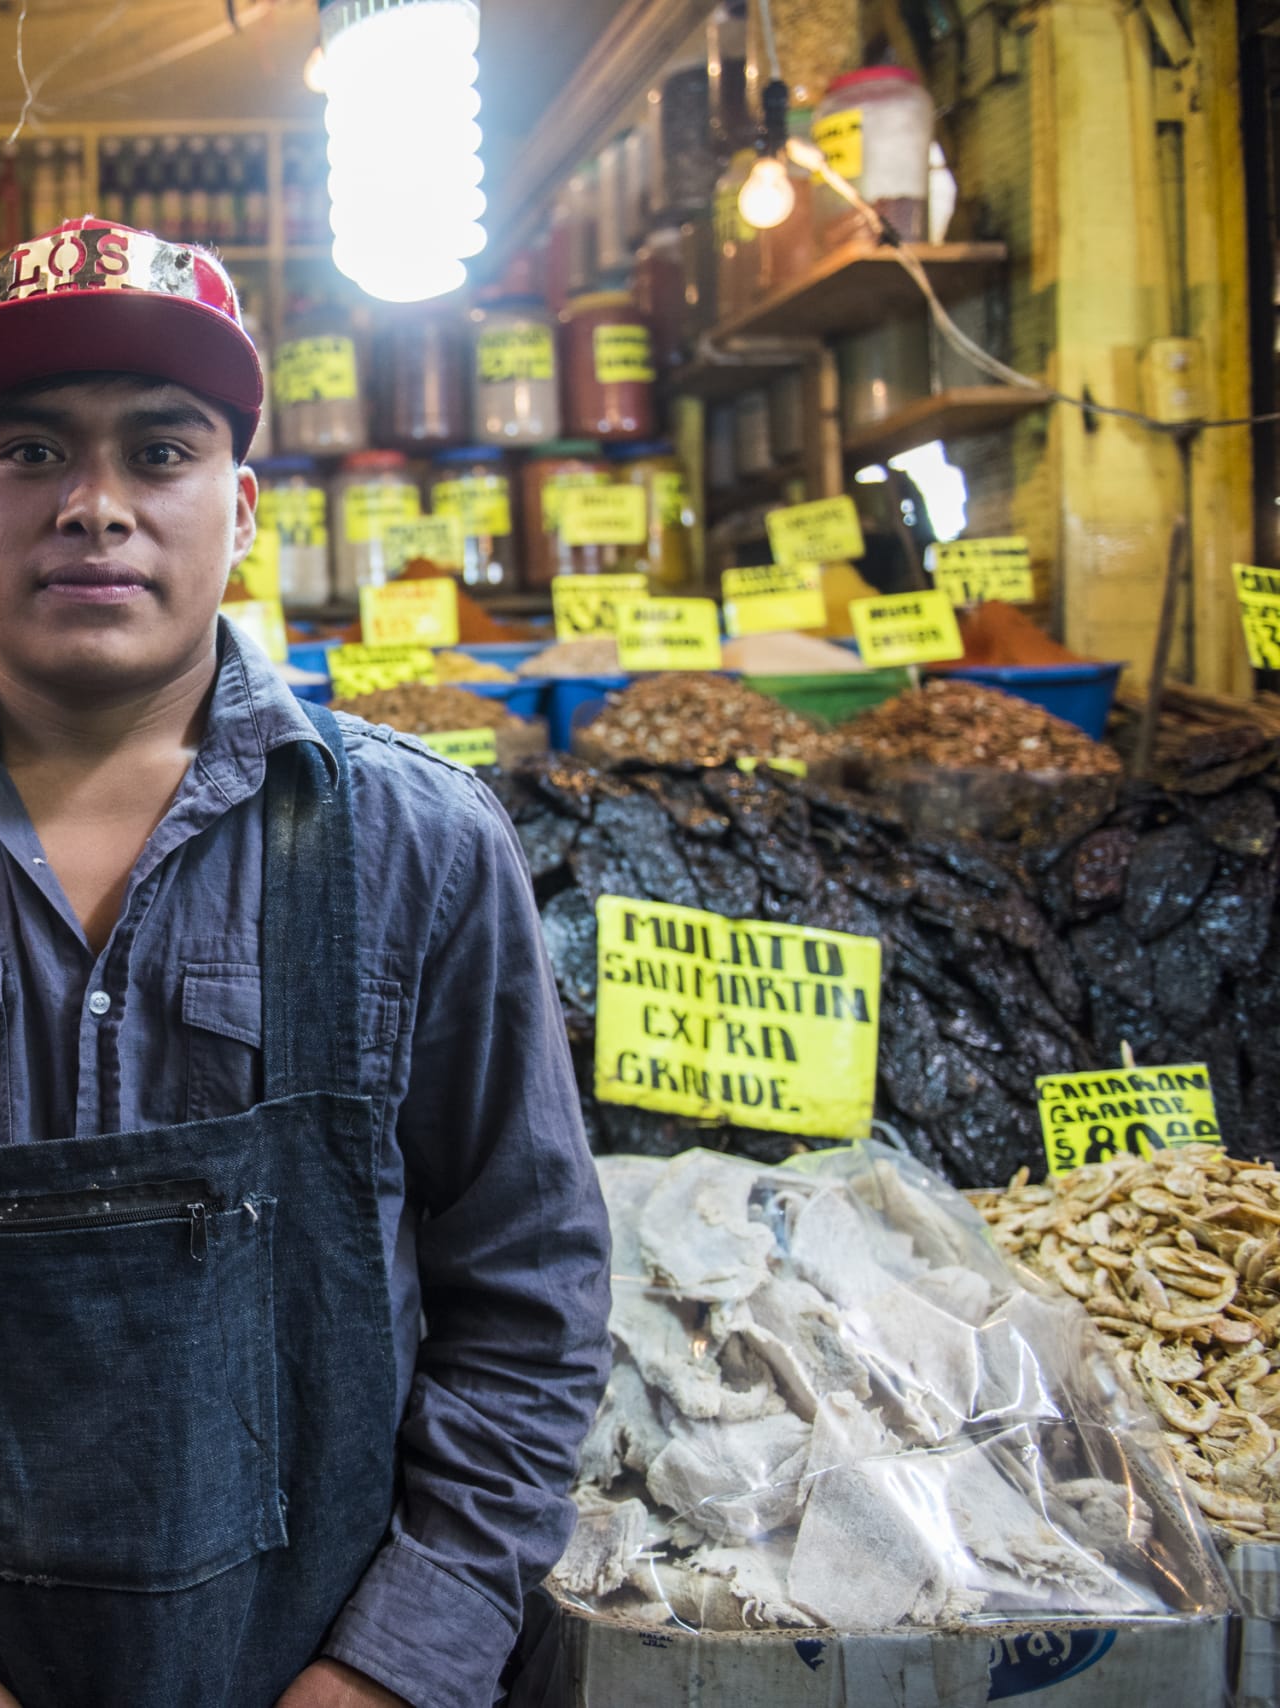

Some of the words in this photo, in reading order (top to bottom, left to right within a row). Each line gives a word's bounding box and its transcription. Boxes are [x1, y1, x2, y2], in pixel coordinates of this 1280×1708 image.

[9, 233, 129, 291] LOS
[623, 911, 845, 977] MULATO
[643, 1003, 798, 1063] EXTRA
[1050, 1097, 1193, 1124] GRANDE
